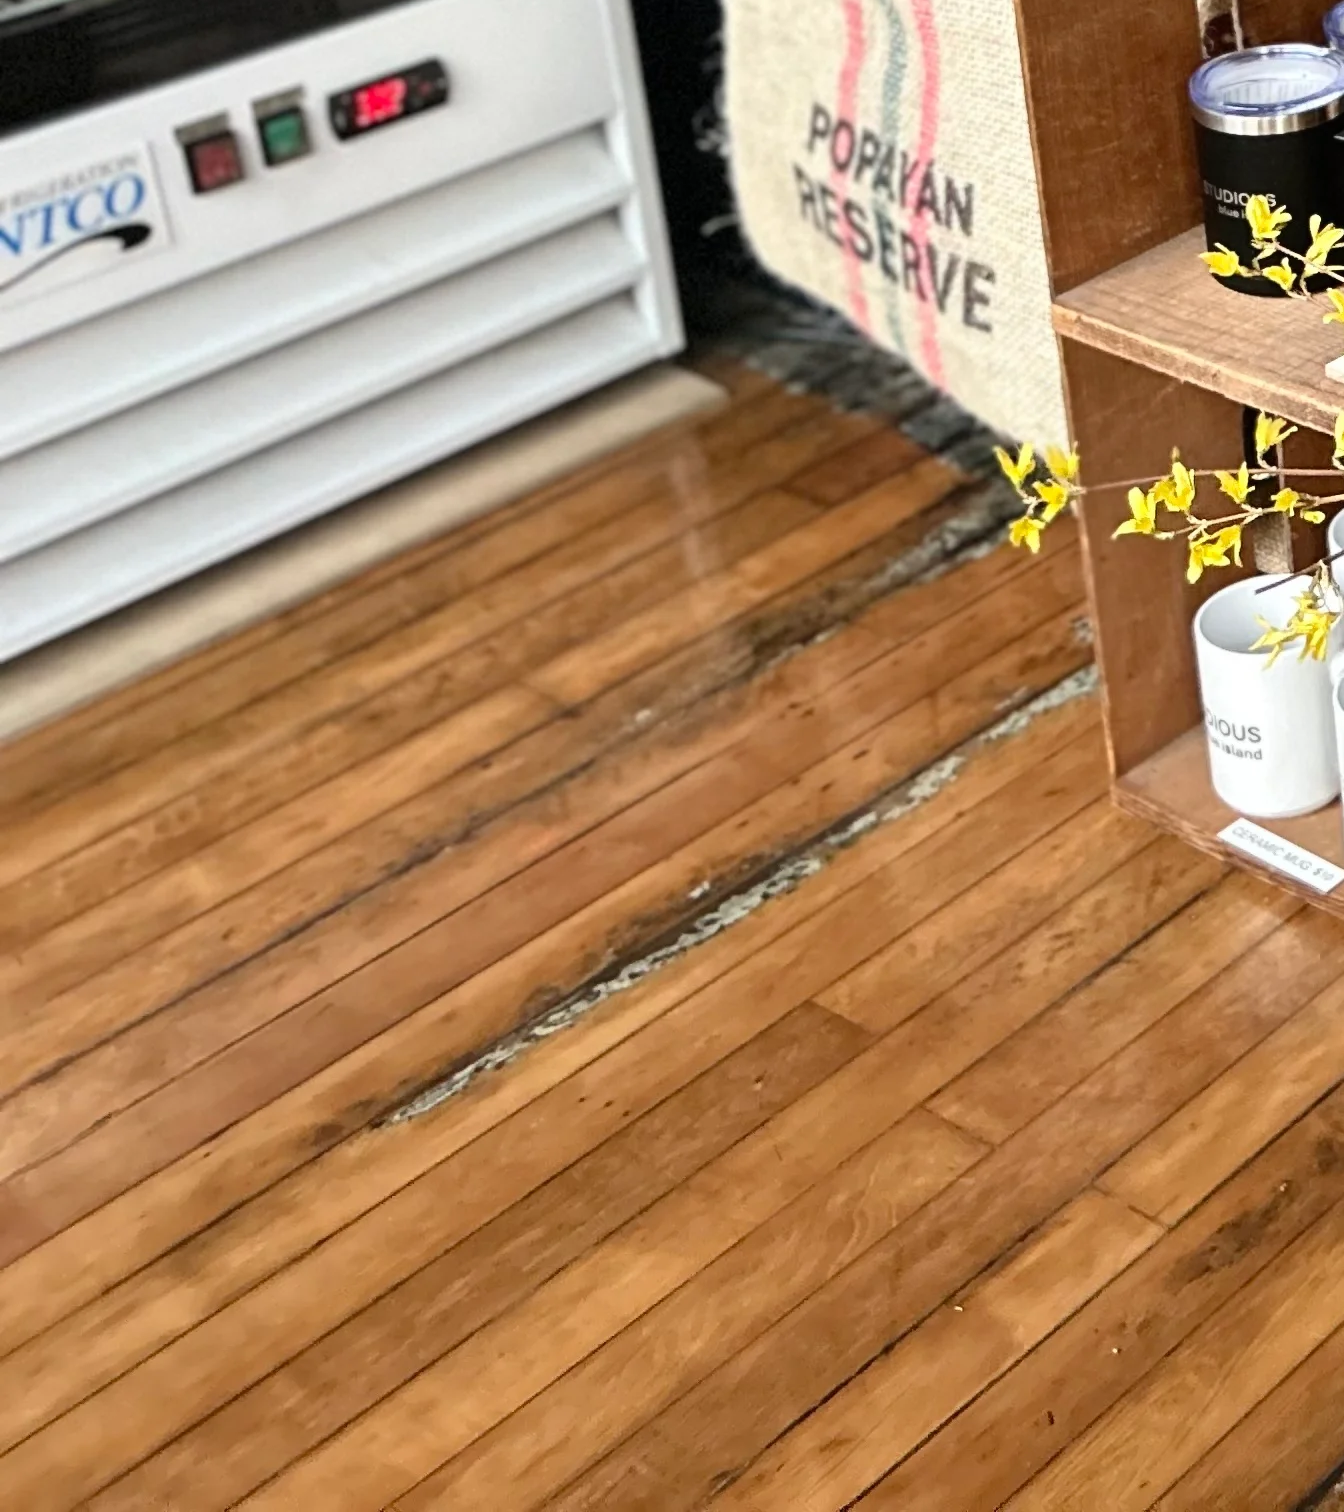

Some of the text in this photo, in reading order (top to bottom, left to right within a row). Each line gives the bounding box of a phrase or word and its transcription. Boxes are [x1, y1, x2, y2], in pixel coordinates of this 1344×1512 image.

[806, 101, 975, 237] POPAYAN
[1203, 179, 1277, 208] STUDIOS
[0, 171, 147, 257] NTCO
[791, 161, 997, 334] RESERVE
[1283, 851, 1313, 871] MUG
